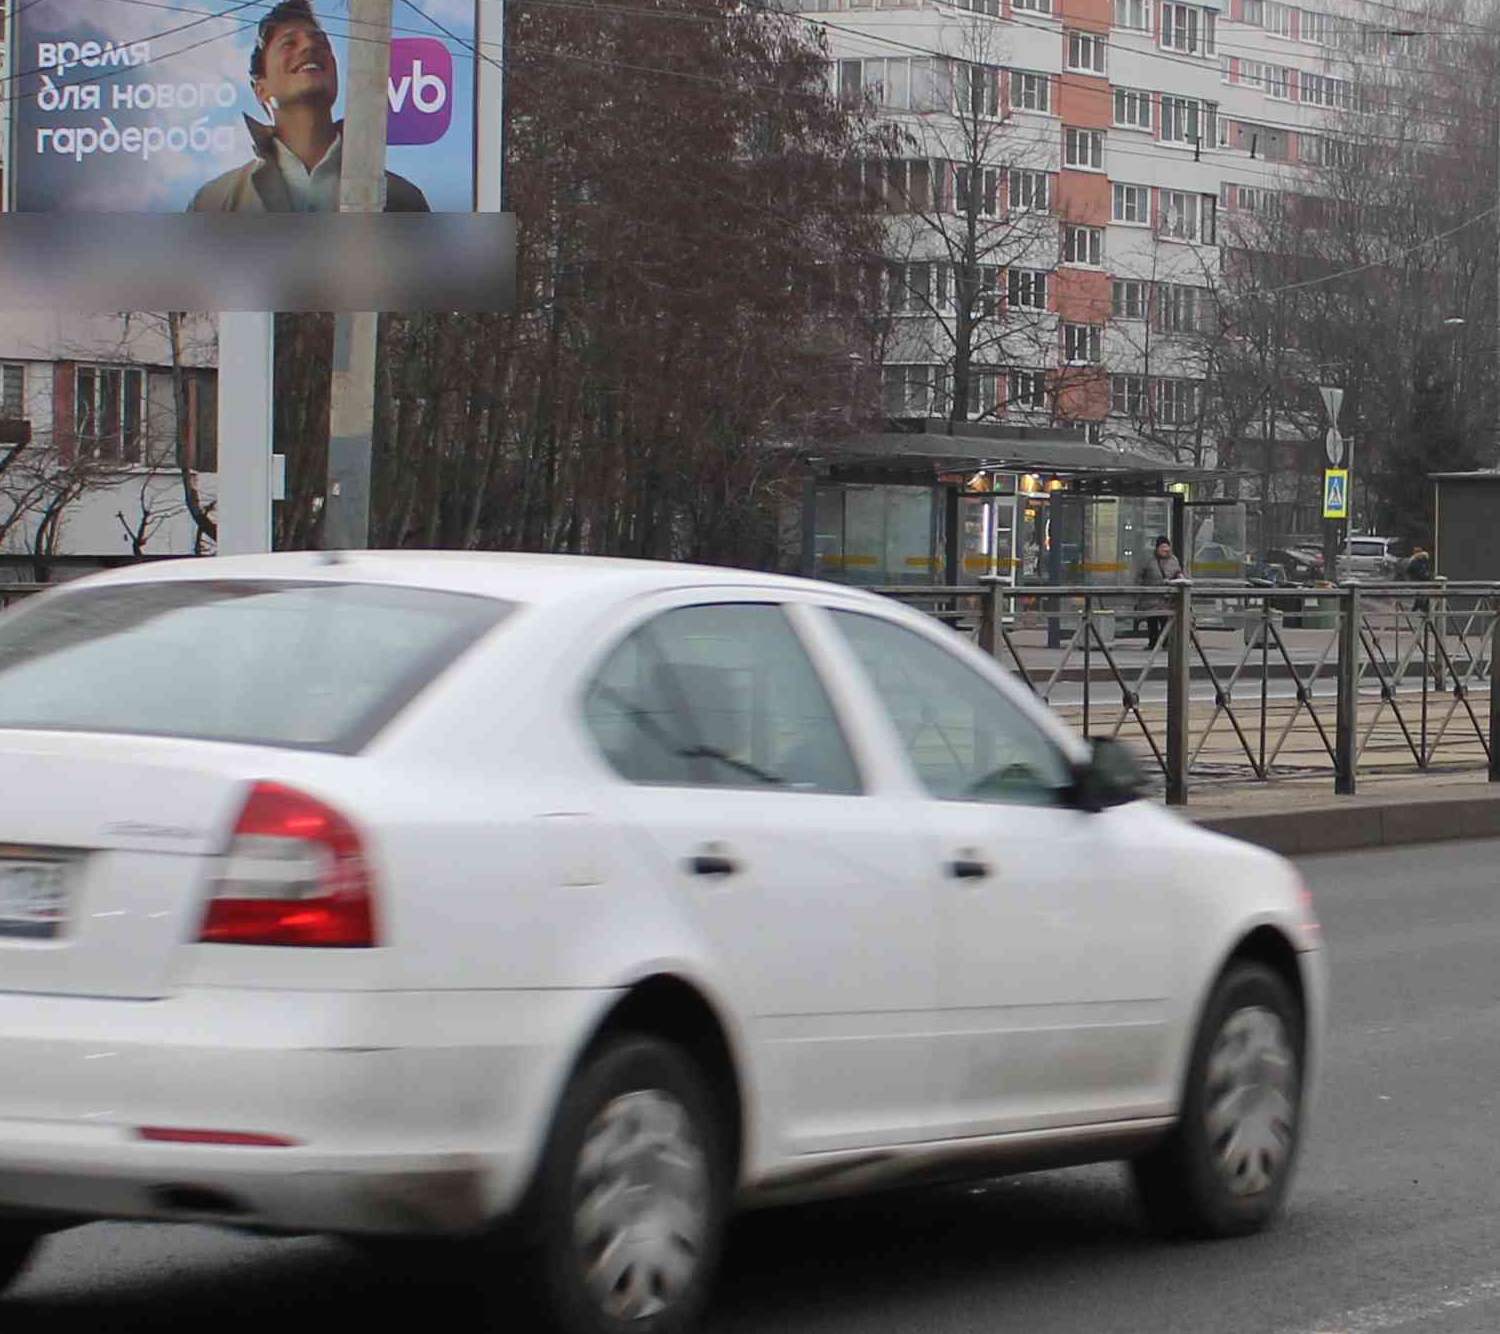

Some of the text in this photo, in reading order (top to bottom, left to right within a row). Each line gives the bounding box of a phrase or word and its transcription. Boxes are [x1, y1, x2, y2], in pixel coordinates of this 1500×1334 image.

[37, 41, 150, 76] время
[37, 74, 237, 111] для нового
[36, 116, 235, 162] гардероба
